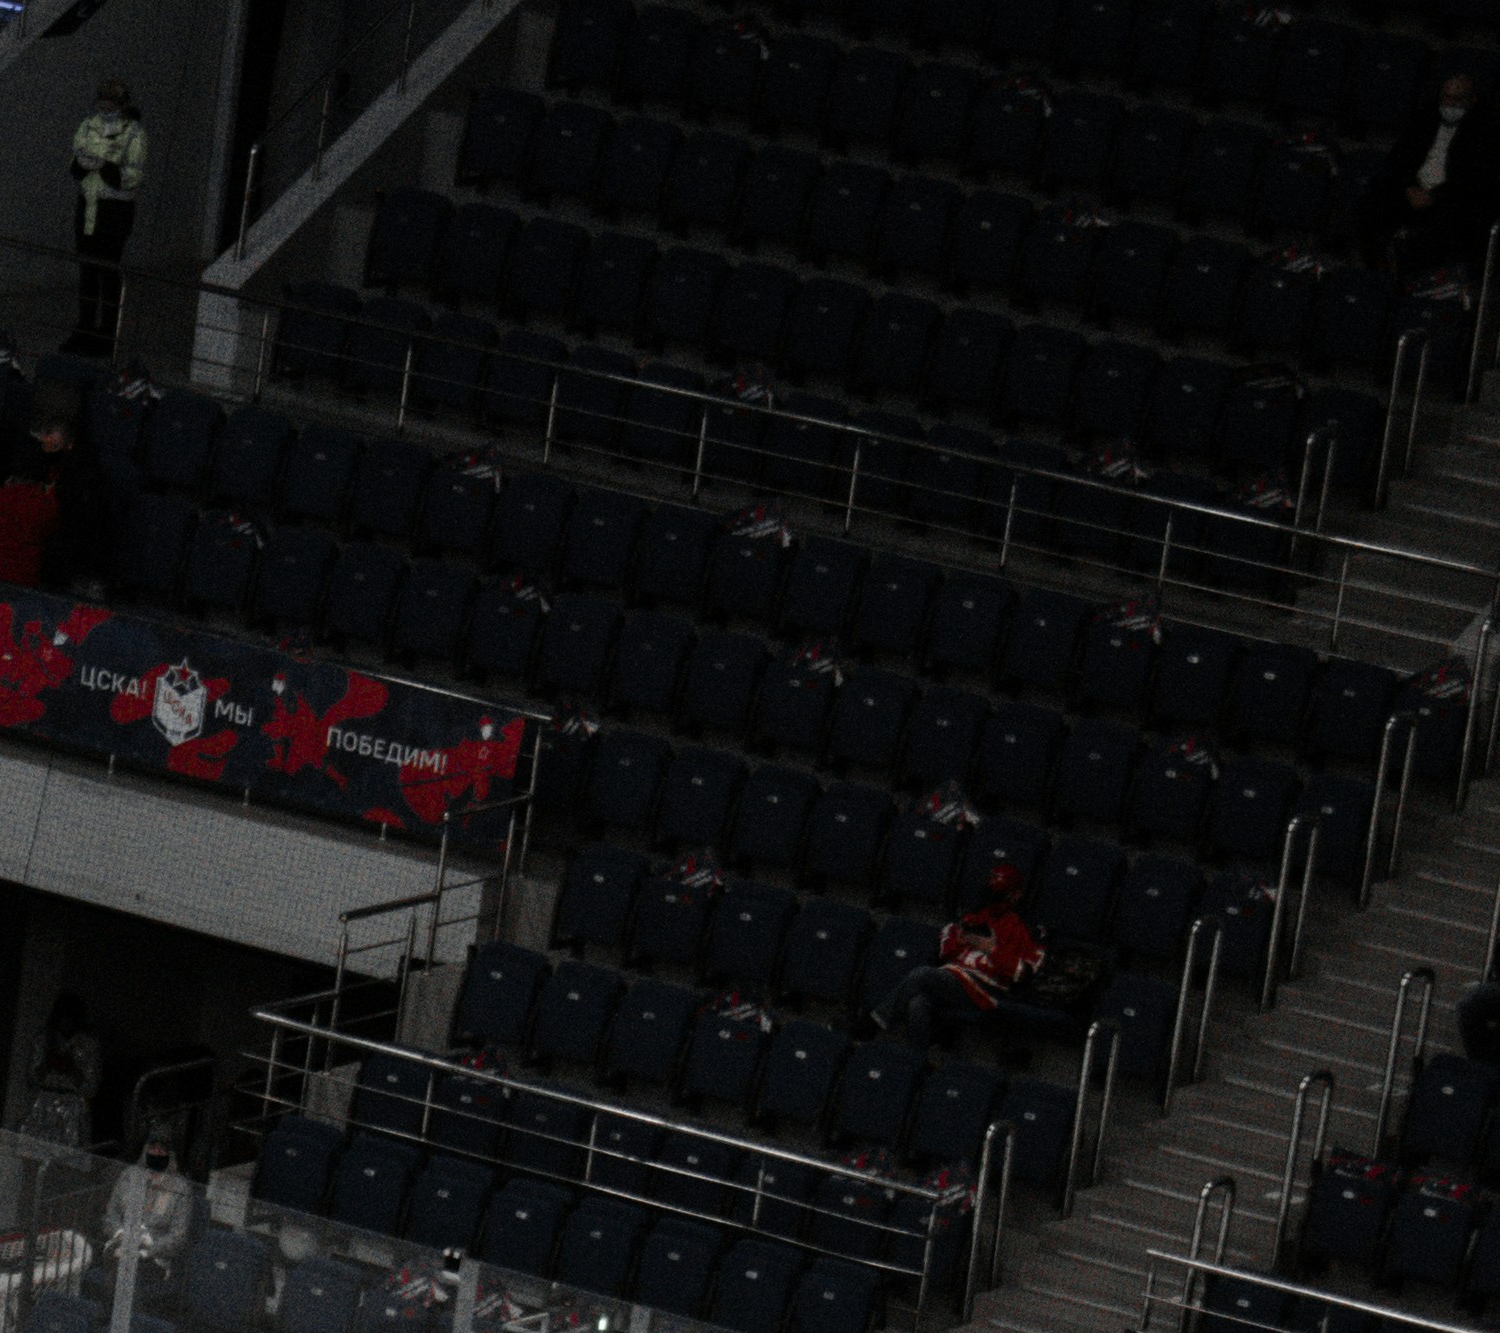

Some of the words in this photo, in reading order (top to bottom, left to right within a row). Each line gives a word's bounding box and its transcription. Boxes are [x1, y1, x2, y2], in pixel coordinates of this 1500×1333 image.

[80, 665, 148, 699] ЦСКА!
[215, 699, 255, 727] МЫ
[327, 727, 449, 776] ПОБЕДИМ!
